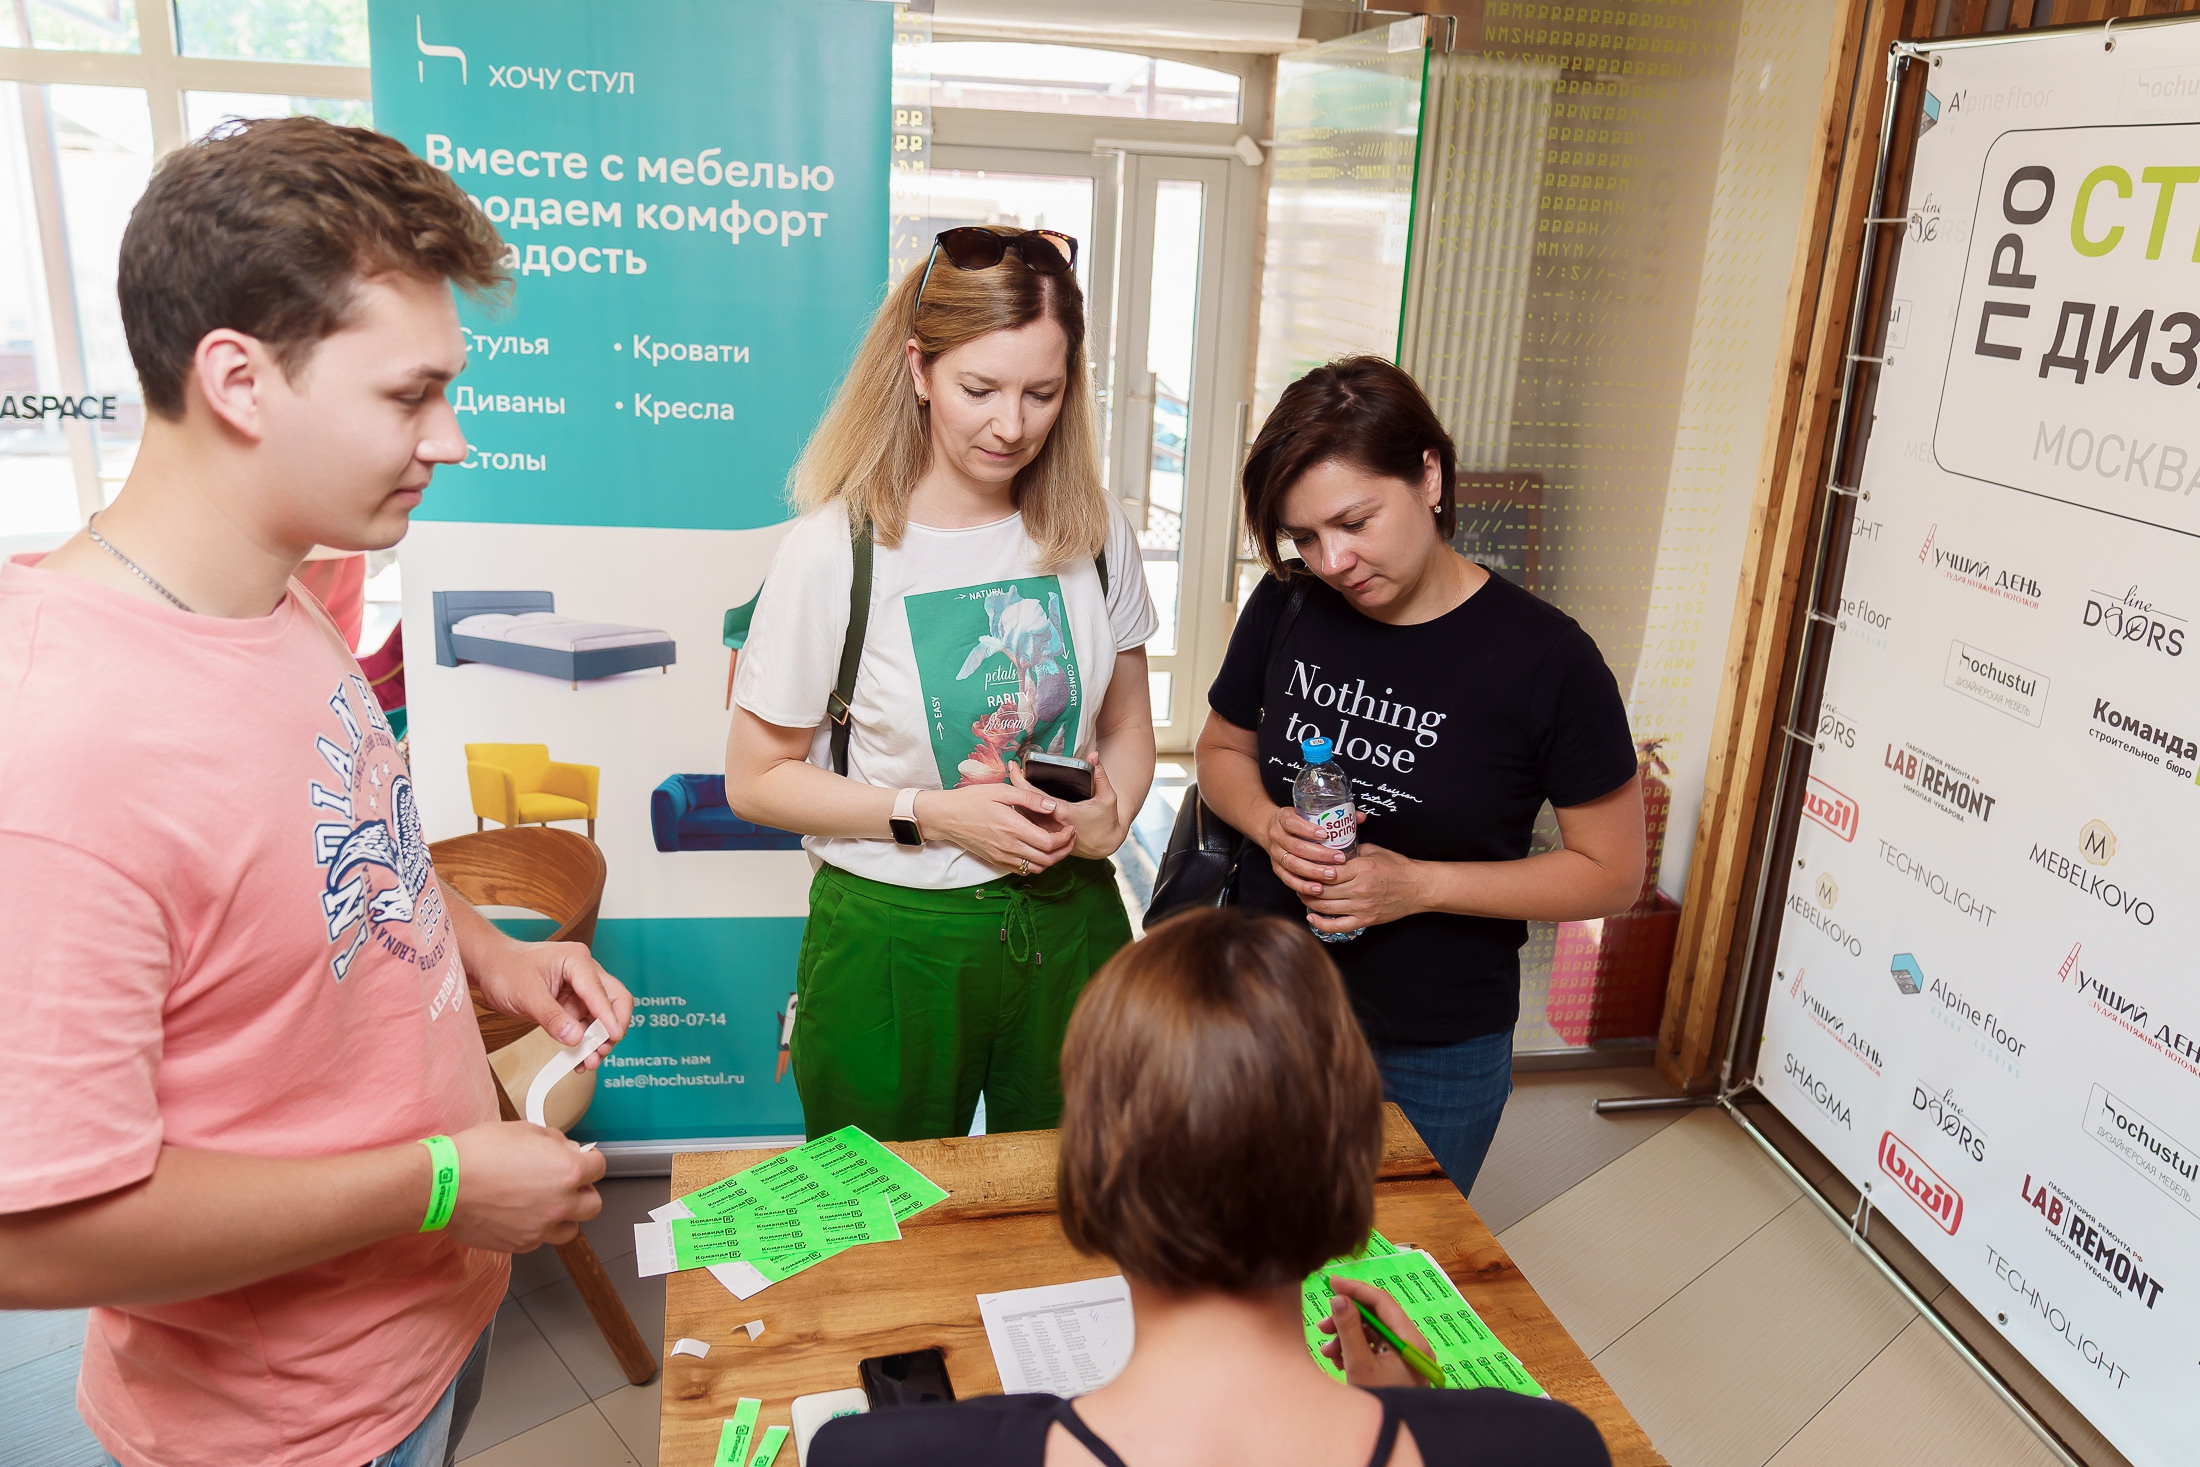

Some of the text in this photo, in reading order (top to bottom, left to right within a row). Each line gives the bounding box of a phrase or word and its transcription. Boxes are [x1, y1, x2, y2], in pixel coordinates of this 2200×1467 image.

[488, 64, 635, 94] ХОЧУ СТУЛ
[425, 133, 835, 192] Вместе с мебелью
[467, 193, 829, 247] одаем комфорт
[2070, 165, 2200, 263] СТ
[499, 241, 647, 277] адость
[1975, 165, 2056, 361] ПРО
[461, 327, 550, 360] Стулья
[632, 335, 750, 366] Кровати
[2039, 301, 2200, 386] ДИЗ
[0, 395, 116, 420] ASPACE
[453, 386, 566, 415] Диваны
[634, 394, 735, 425] Кресла
[460, 445, 546, 472] Столы
[1995, 570, 2042, 599] ДЕНЬ
[2123, 584, 2153, 612] line
[984, 662, 1018, 691] petals
[1066, 664, 1078, 707] COMFORT
[930, 696, 942, 719] EASY
[987, 691, 1030, 708] RARITY
[1285, 660, 1447, 748] Nothing
[1332, 719, 1415, 773] lose
[2093, 698, 2199, 762] Команда
[2088, 727, 2193, 780] строительное бюро
[1884, 743, 1996, 822] LAB REMONT
[1326, 813, 1353, 830] saint
[1878, 838, 1996, 927] TECHNOLIGHT
[2029, 842, 2155, 926] MEBELKOVO
[633, 996, 687, 1008] вонить
[1930, 978, 1981, 1026] Alpine
[1984, 1015, 2027, 1058] floor
[650, 1013, 727, 1028] 380-07-14
[604, 1054, 711, 1068] Написать нам
[1847, 1031, 1884, 1069] ДЕНЬ
[2164, 1049, 2200, 1078] ПОТОЛК
[604, 1072, 745, 1089] sale@hochustul.ru
[1783, 1053, 1852, 1131] SHAGMA
[1942, 1087, 1964, 1116] line
[2021, 1173, 2165, 1311] LAB REMONT
[1985, 1243, 2131, 1390] TECHNOLIGHT
